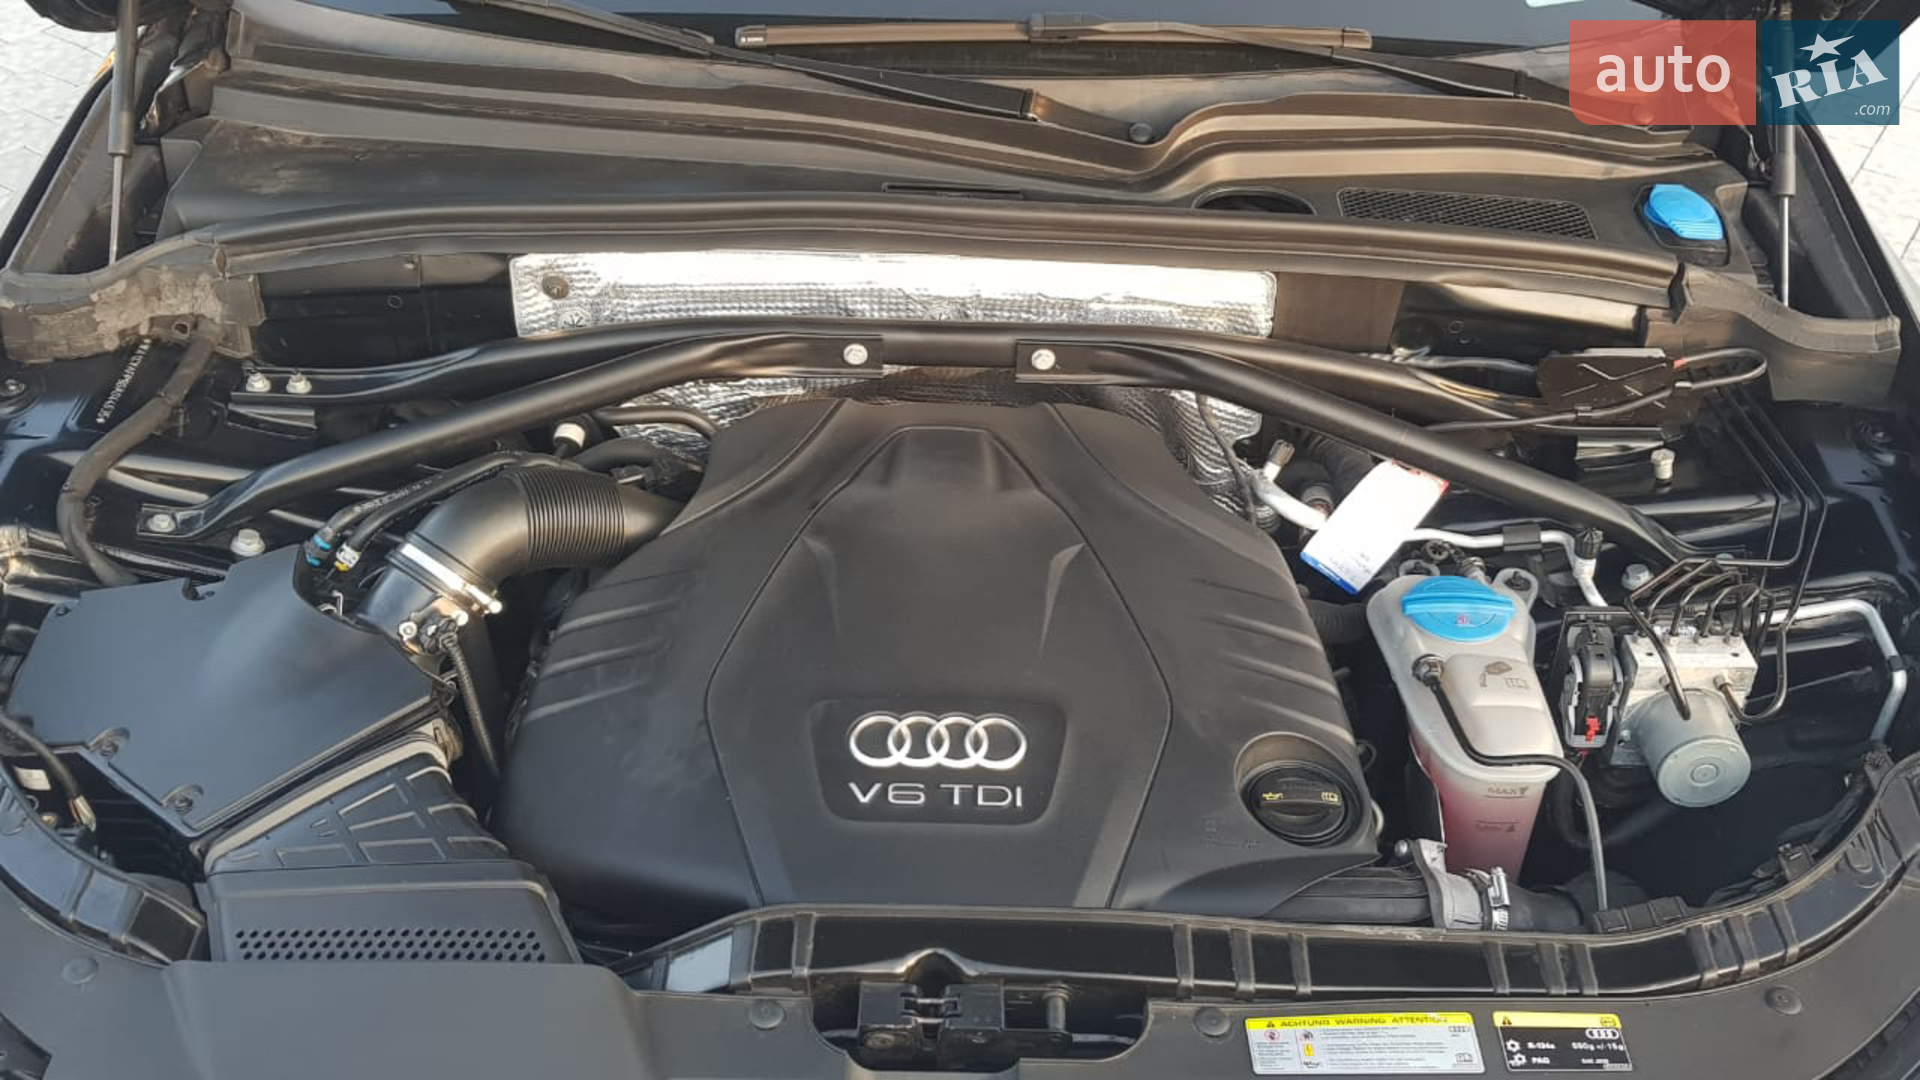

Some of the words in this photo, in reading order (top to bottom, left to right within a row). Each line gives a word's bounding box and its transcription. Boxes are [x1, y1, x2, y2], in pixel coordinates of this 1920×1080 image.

[848, 782, 925, 805] V6
[940, 784, 1023, 807] TDI
[1280, 1020, 1330, 1028] ACHTUNG
[1335, 1018, 1386, 1026] WARNING
